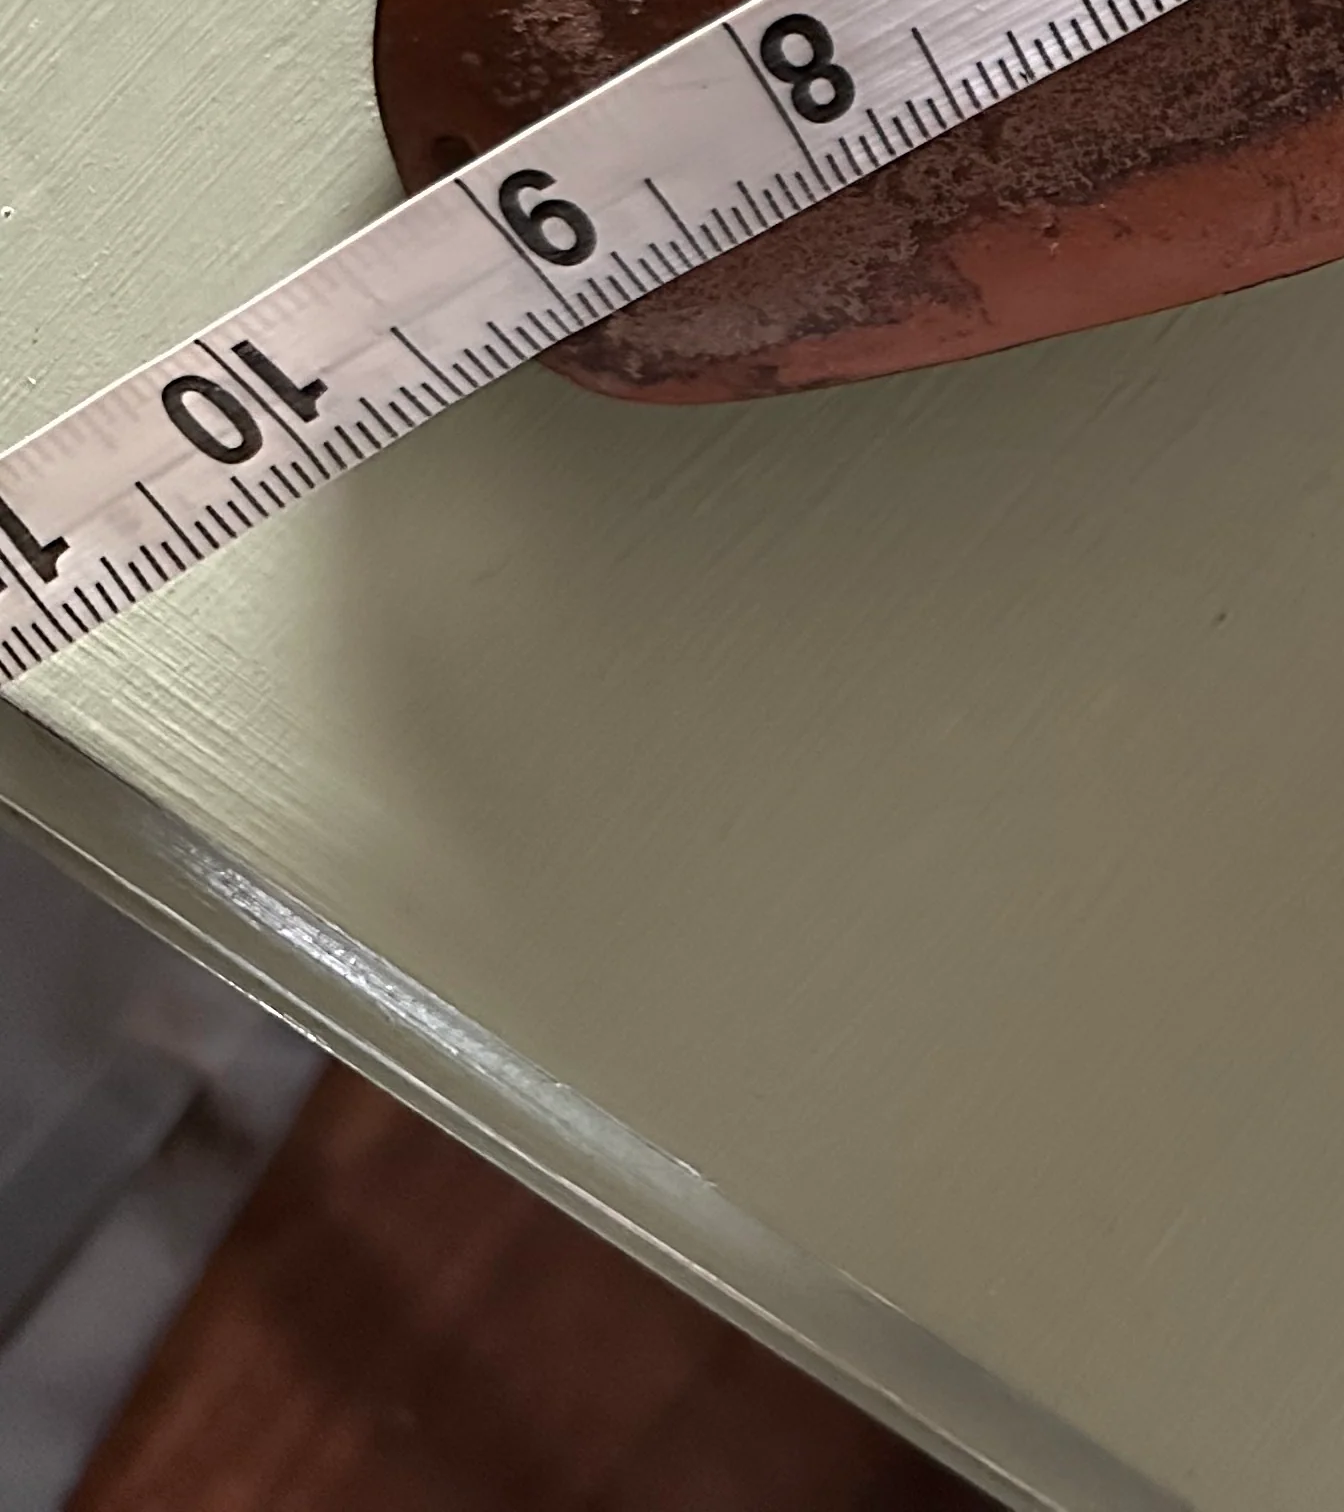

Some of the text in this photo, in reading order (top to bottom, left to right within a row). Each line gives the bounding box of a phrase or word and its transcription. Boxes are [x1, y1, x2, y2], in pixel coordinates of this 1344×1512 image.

[759, 13, 857, 124] 8
[497, 169, 598, 267] 9
[160, 339, 329, 465] 10
